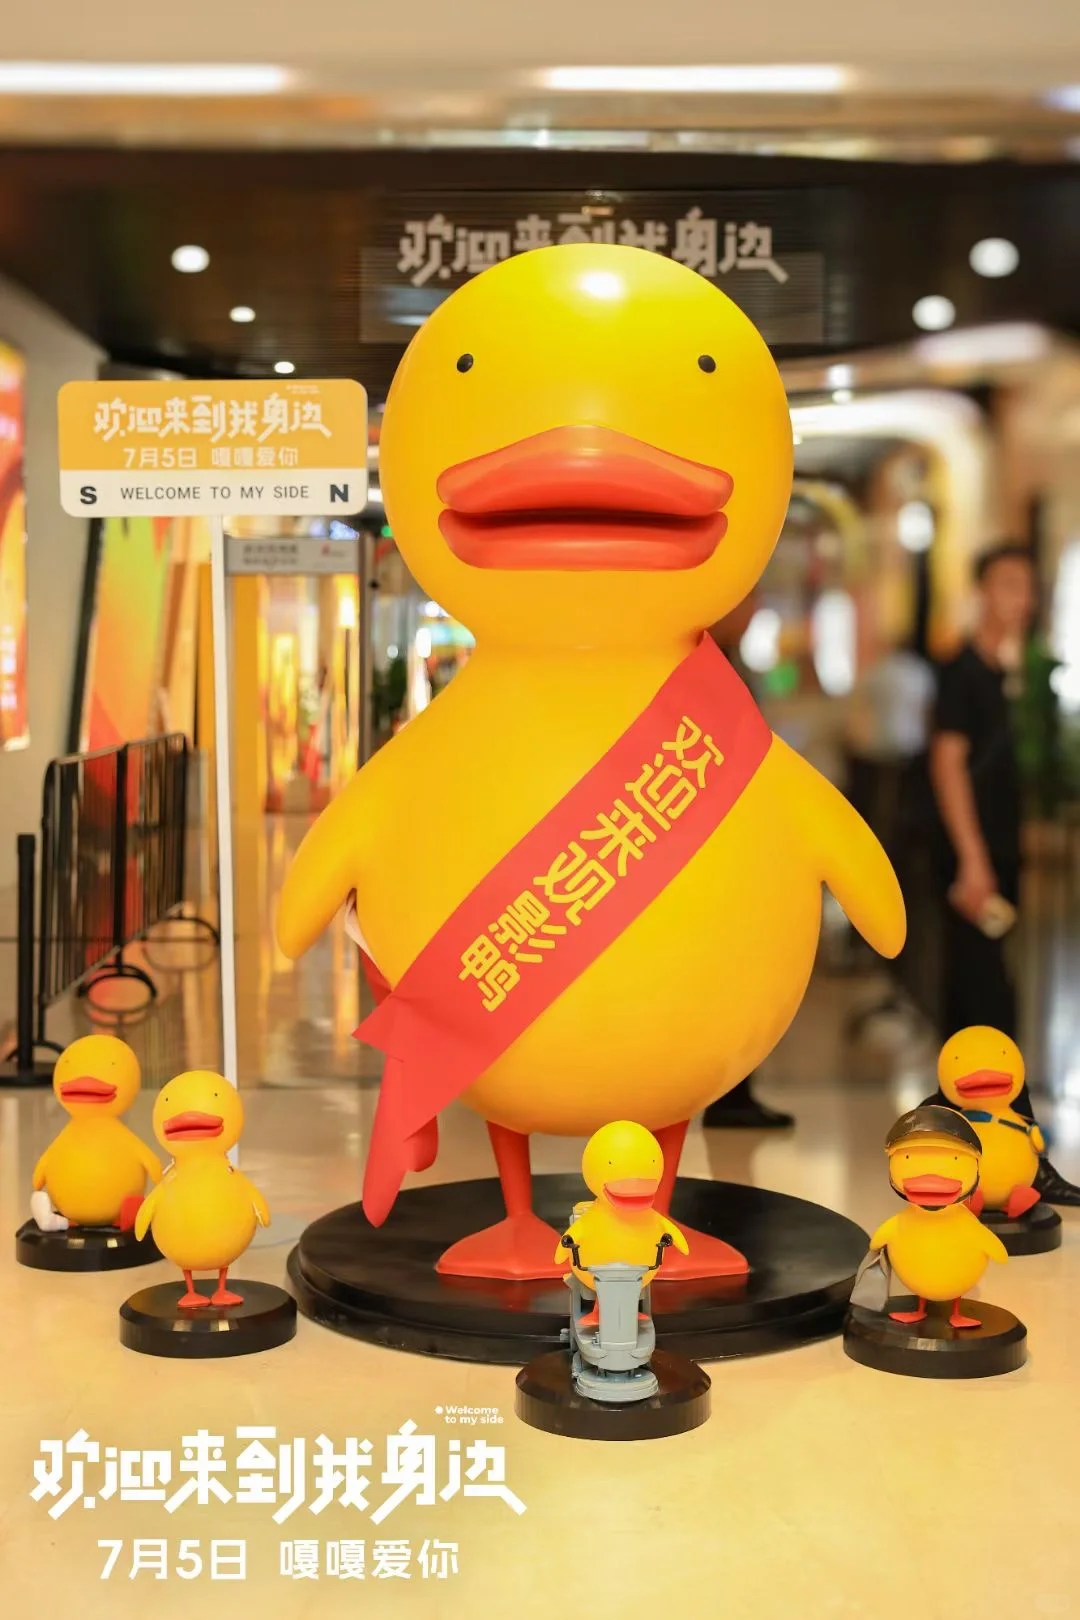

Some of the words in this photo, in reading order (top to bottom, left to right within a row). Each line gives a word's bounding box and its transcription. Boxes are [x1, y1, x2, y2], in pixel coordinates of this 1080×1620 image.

[93, 392, 332, 443] 欢迎来到我身边
[123, 448, 197, 468] 7月5日
[80, 486, 97, 505] S
[121, 486, 200, 500] WELCOME
[210, 486, 231, 499] TO
[240, 486, 264, 499] MY
[273, 485, 309, 499] SIDE
[330, 484, 349, 503] N
[458, 715, 725, 1012] 欢迎来观影鸭
